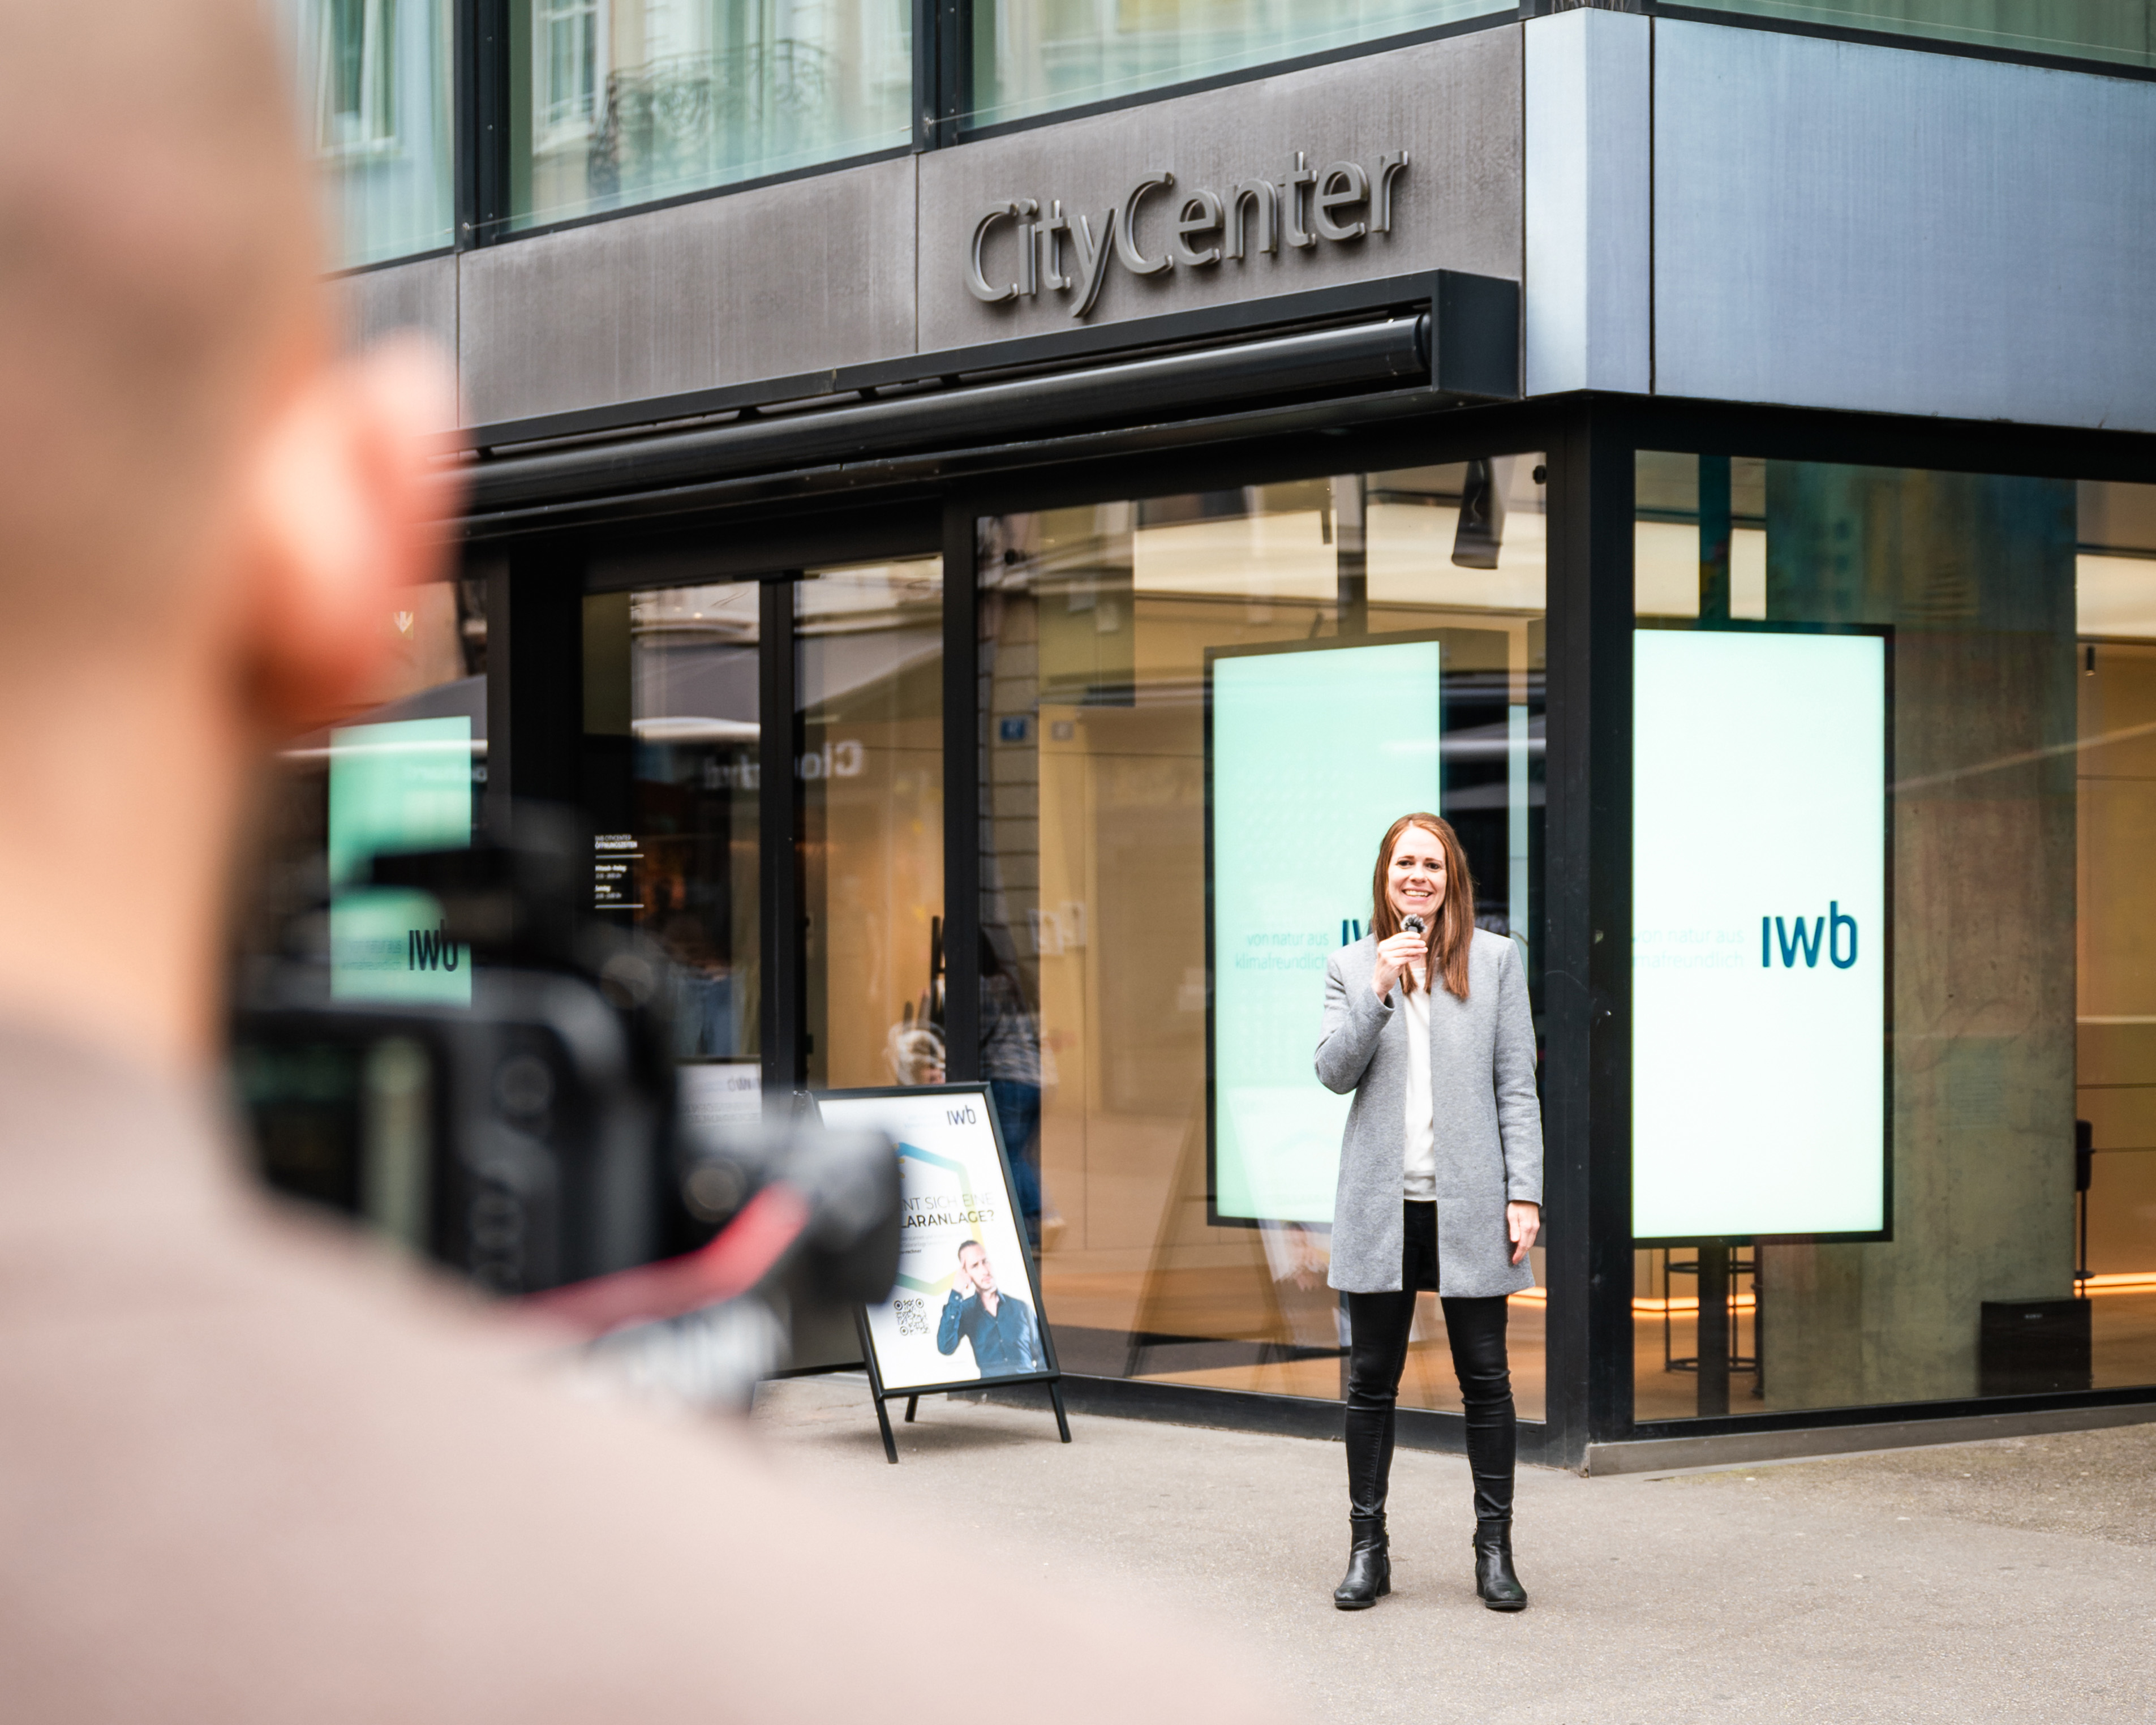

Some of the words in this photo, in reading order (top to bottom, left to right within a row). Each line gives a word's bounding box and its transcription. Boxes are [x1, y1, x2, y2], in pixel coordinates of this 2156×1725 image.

[965, 151, 1408, 318] CityCenter
[1247, 934, 1269, 946] von
[1273, 932, 1304, 946] natur
[1307, 933, 1329, 946] aus
[1668, 928, 1711, 943] natur
[1715, 929, 1745, 944] aus
[1633, 949, 1744, 969] mafreundlich
[902, 1197, 921, 1212] NT
[925, 1195, 958, 1210] SICH
[963, 1192, 995, 1207] EINE
[901, 1209, 994, 1229] ARANLAGE?
